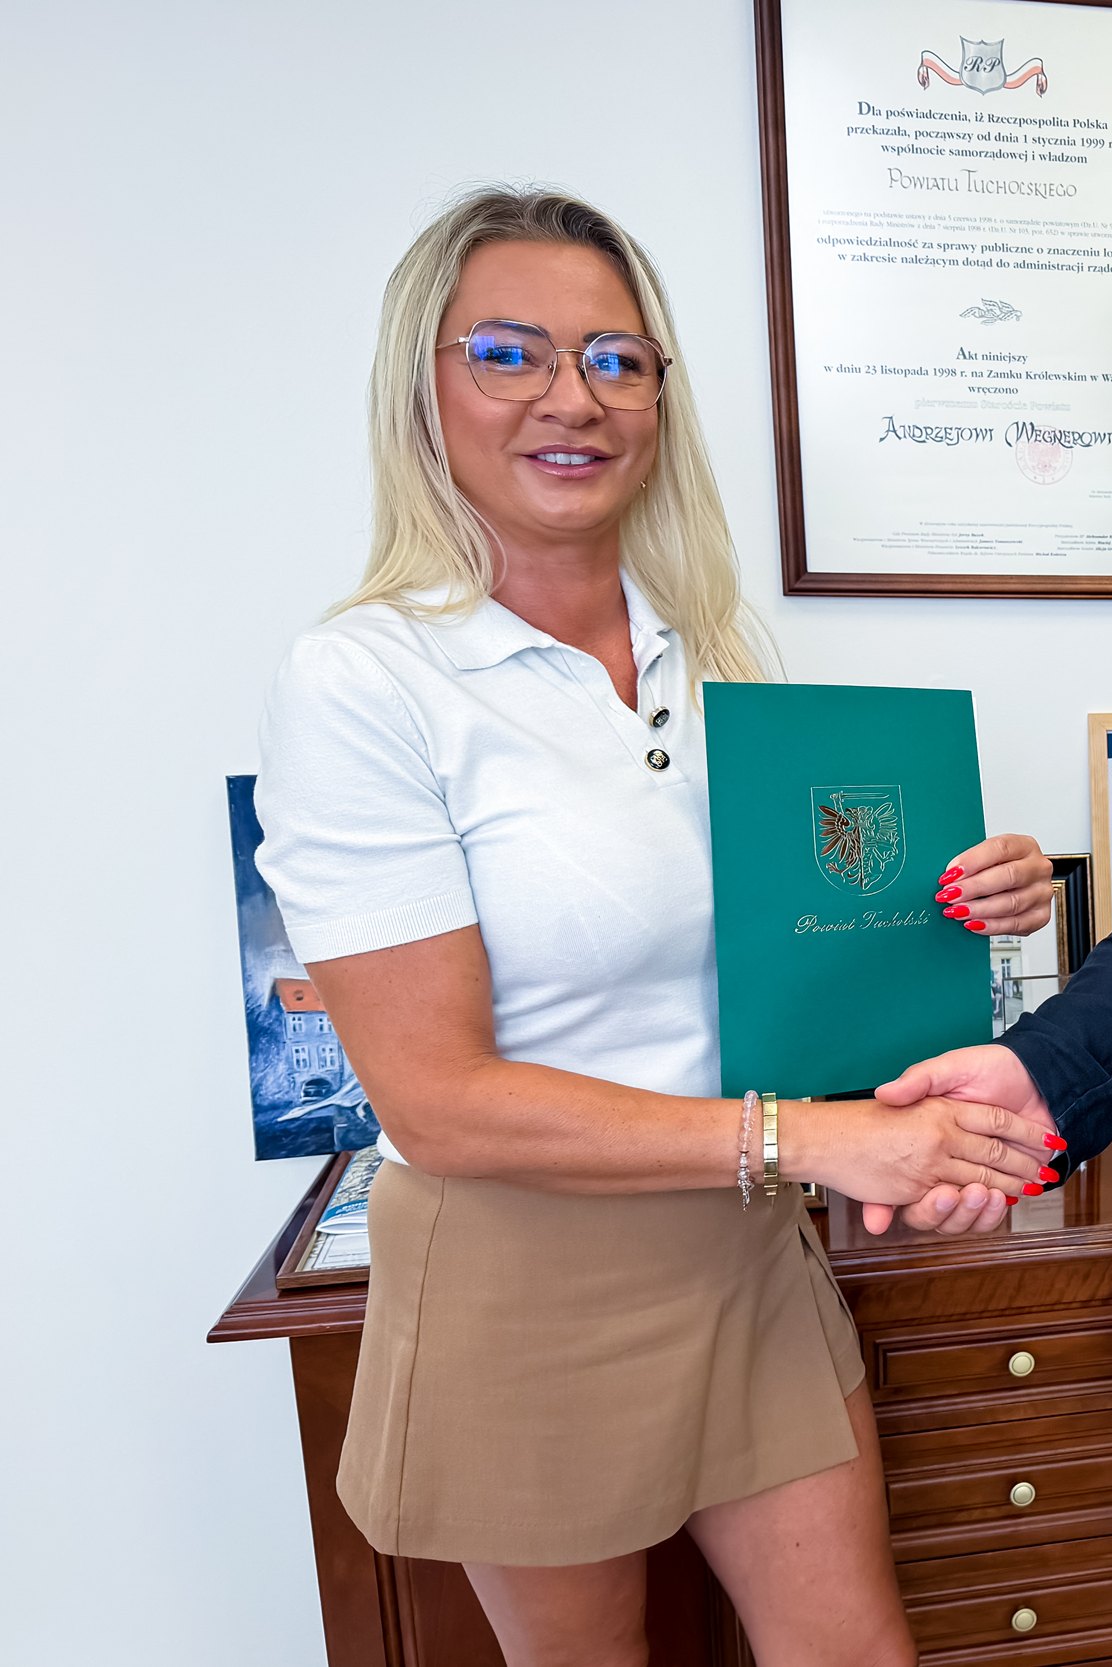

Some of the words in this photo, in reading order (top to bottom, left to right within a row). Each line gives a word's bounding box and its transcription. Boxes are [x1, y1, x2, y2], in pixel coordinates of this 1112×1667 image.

[964, 56, 1000, 73] RP
[858, 101, 882, 116] Dla
[886, 107, 971, 123] poświadczenia,
[974, 112, 984, 122] iż
[987, 114, 1070, 128] Rzeczpospolita
[1072, 118, 1108, 130] Polska
[846, 124, 910, 138] przekazała,
[914, 130, 974, 142] począwszy
[976, 132, 990, 142] od
[994, 132, 1018, 143] dnia
[1023, 134, 1028, 144] 1
[1032, 136, 1076, 147] stycznia
[1080, 137, 1104, 148] 1999
[880, 144, 945, 156] wspólnocie
[949, 148, 1028, 162] samorządowej
[1032, 150, 1035, 160] i
[816, 234, 918, 249] odpowiedzialność
[922, 241, 934, 249] za
[936, 242, 977, 253] sprawy
[980, 242, 1034, 254] publiczne
[1036, 246, 1044, 254] o
[1046, 246, 1100, 257] znaczeniu
[850, 252, 898, 263] zakresie
[901, 254, 959, 268] należącym
[962, 257, 992, 269] dotąd
[996, 258, 1010, 268] do
[1013, 260, 1084, 274] administracji
[956, 346, 978, 360] Akt
[982, 352, 1028, 364] niniejszy
[836, 364, 862, 374] dniu
[865, 365, 877, 374] 23
[881, 365, 929, 378] listopada
[933, 367, 956, 378] 1998
[986, 370, 1022, 380] Zamku
[1026, 370, 1087, 382] Królewskim
[968, 384, 1018, 396] wręczono
[794, 914, 856, 934] Powiat
